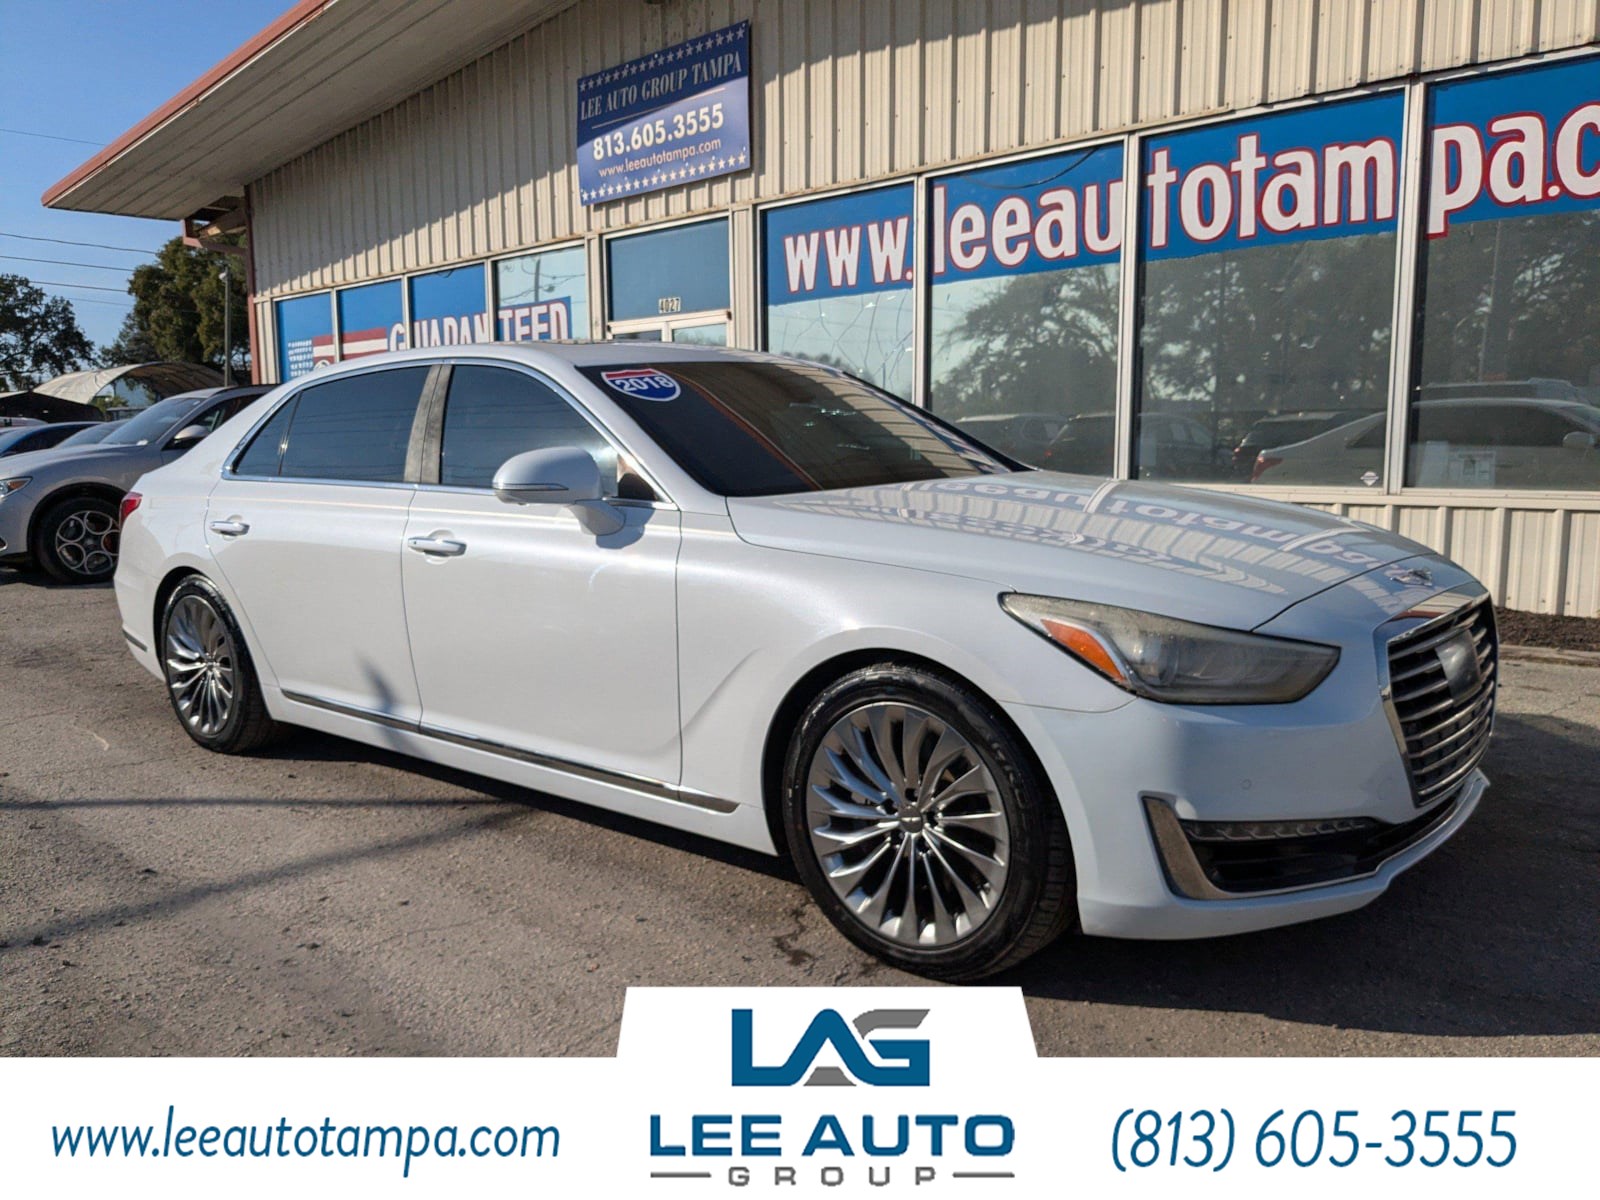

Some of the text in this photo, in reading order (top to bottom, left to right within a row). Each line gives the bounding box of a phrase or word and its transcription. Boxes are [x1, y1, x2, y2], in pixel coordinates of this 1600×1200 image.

[580, 51, 742, 121] LEE AUTO GROUP TAMPA
[593, 103, 724, 161] 813.605.3555
[598, 139, 721, 177] www.leeautotampa.com
[615, 375, 674, 392] 2018
